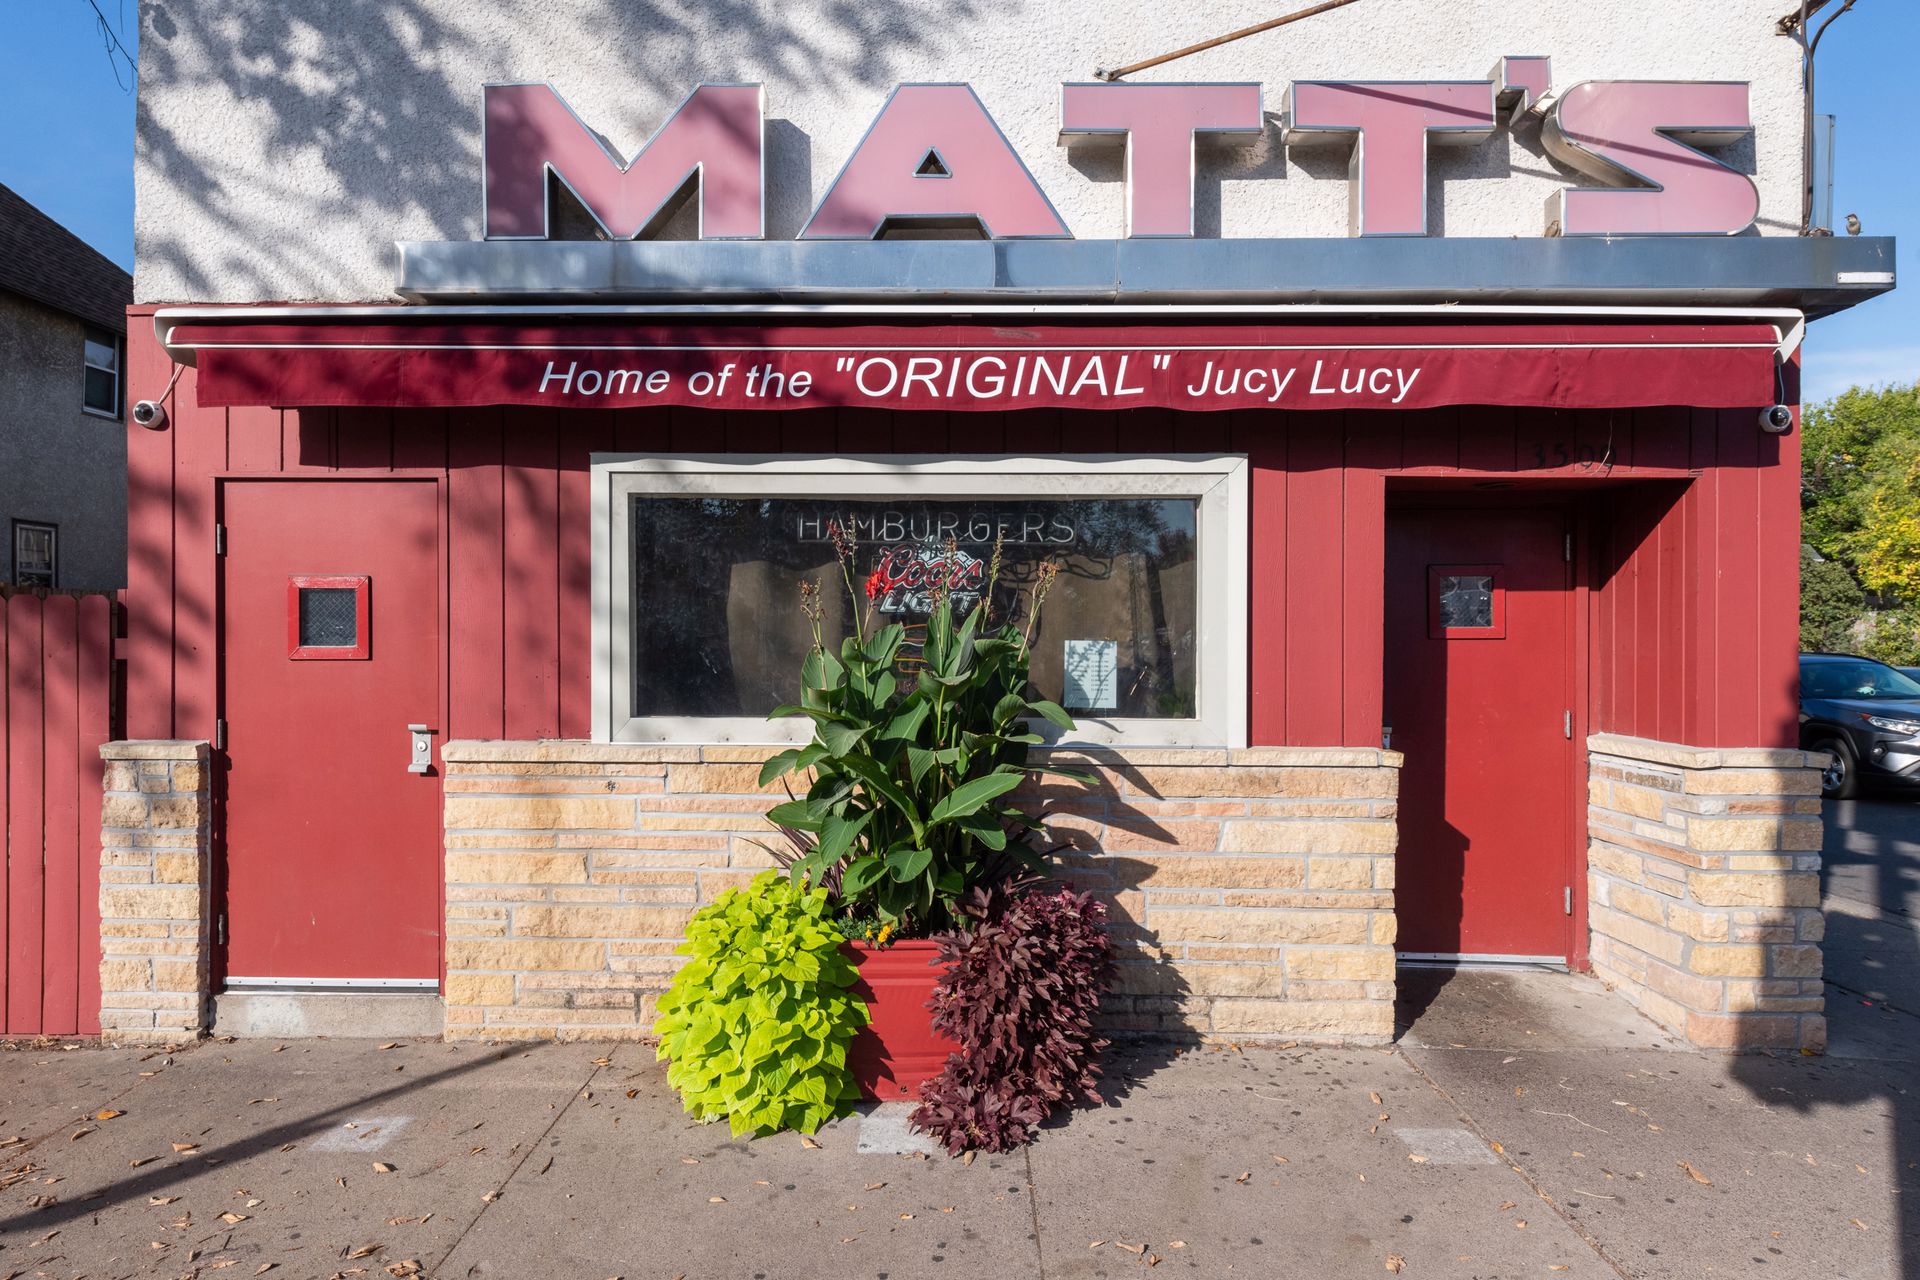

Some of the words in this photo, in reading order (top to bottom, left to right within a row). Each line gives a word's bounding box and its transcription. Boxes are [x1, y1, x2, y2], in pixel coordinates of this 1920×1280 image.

[483, 56, 1760, 241] MATT'S
[539, 360, 671, 399] Home
[687, 363, 737, 397] of
[745, 363, 813, 398] the
[836, 354, 1172, 399] "ORIGINAL"
[1186, 360, 1297, 403] Jucy
[1308, 360, 1422, 404] Lucy
[798, 510, 1075, 542] HAMBURGERS
[877, 544, 987, 590] Coors
[879, 591, 980, 615] LIGT
